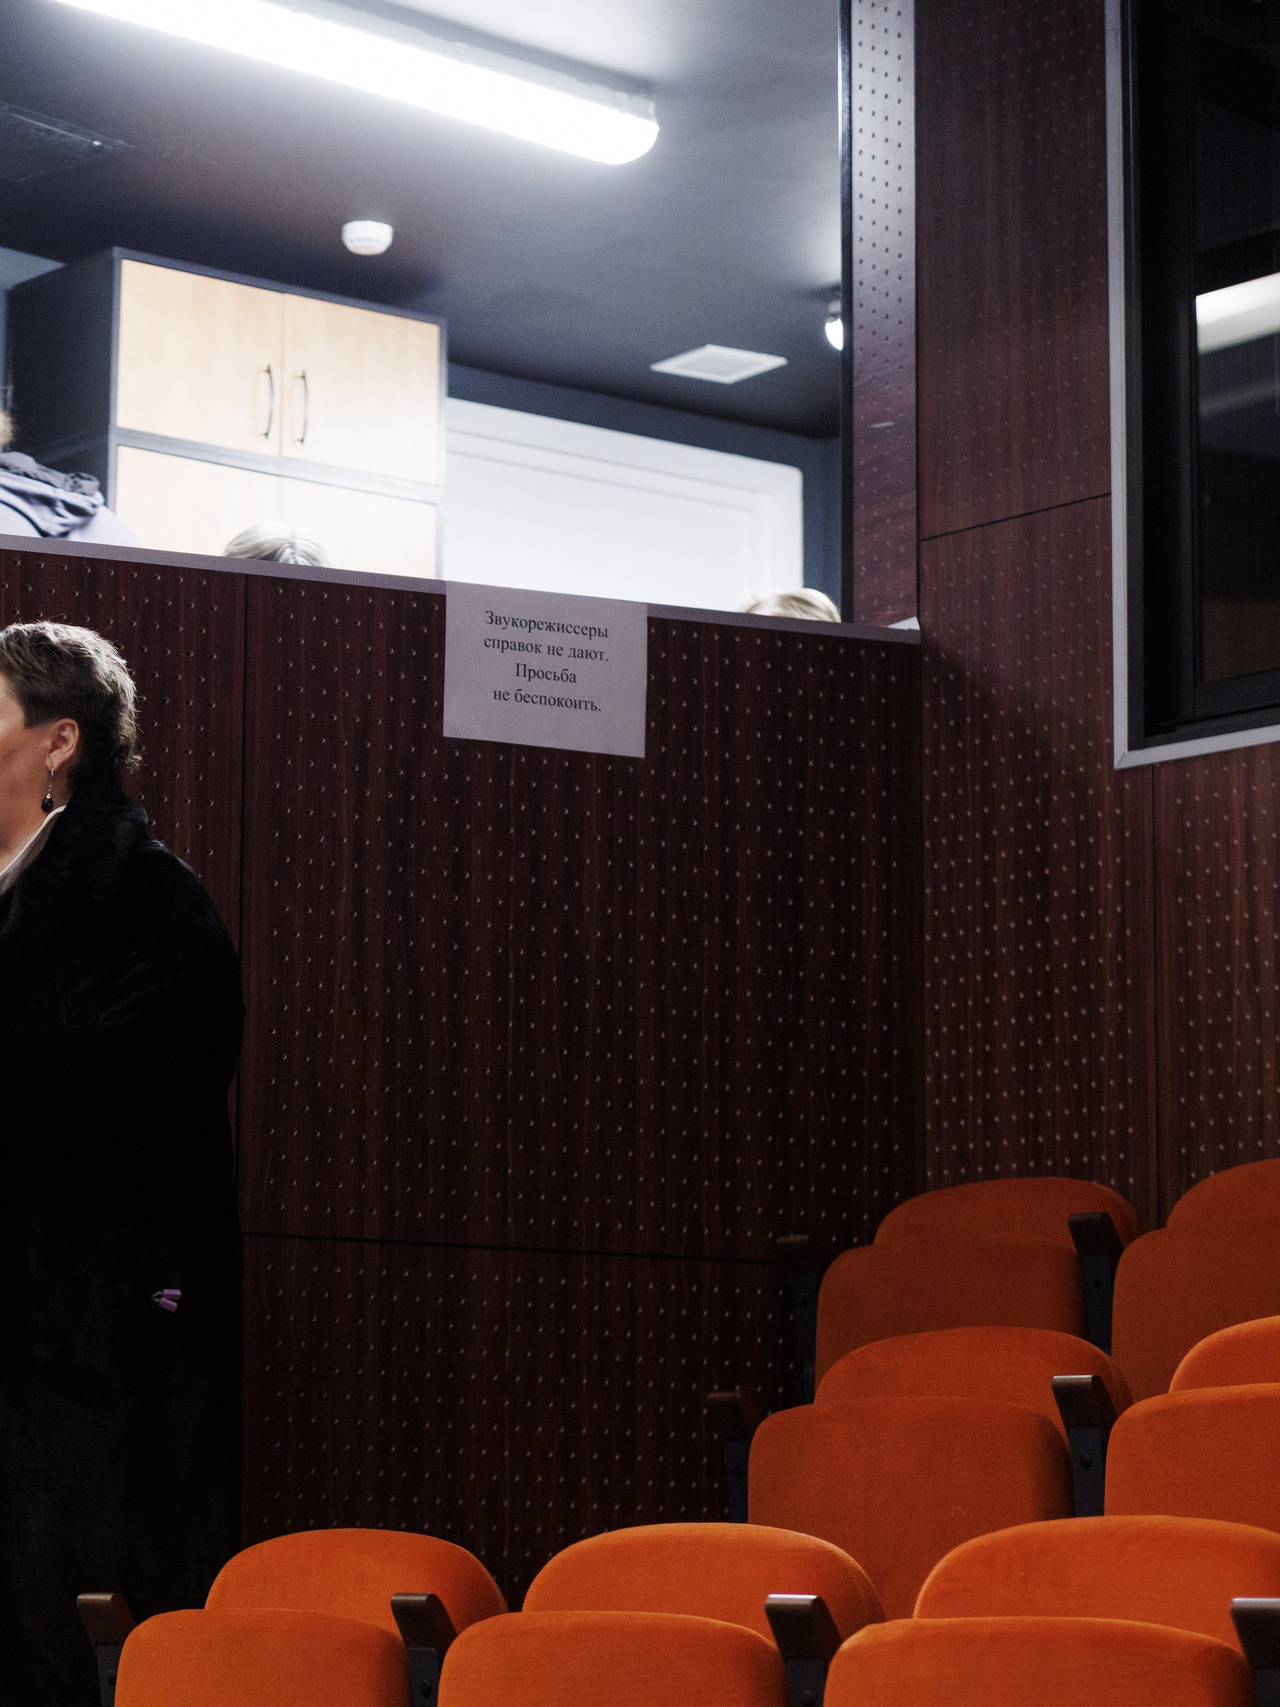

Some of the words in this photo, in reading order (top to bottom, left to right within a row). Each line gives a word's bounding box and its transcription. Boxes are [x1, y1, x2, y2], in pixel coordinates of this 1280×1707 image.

[485, 610, 609, 640] Звукорежиссеры
[484, 637, 543, 654] справок
[547, 645, 564, 657] не
[567, 647, 609, 662] дают.
[515, 663, 577, 683] Просьба
[493, 689, 510, 702] не
[514, 688, 602, 712] беспокоить.
